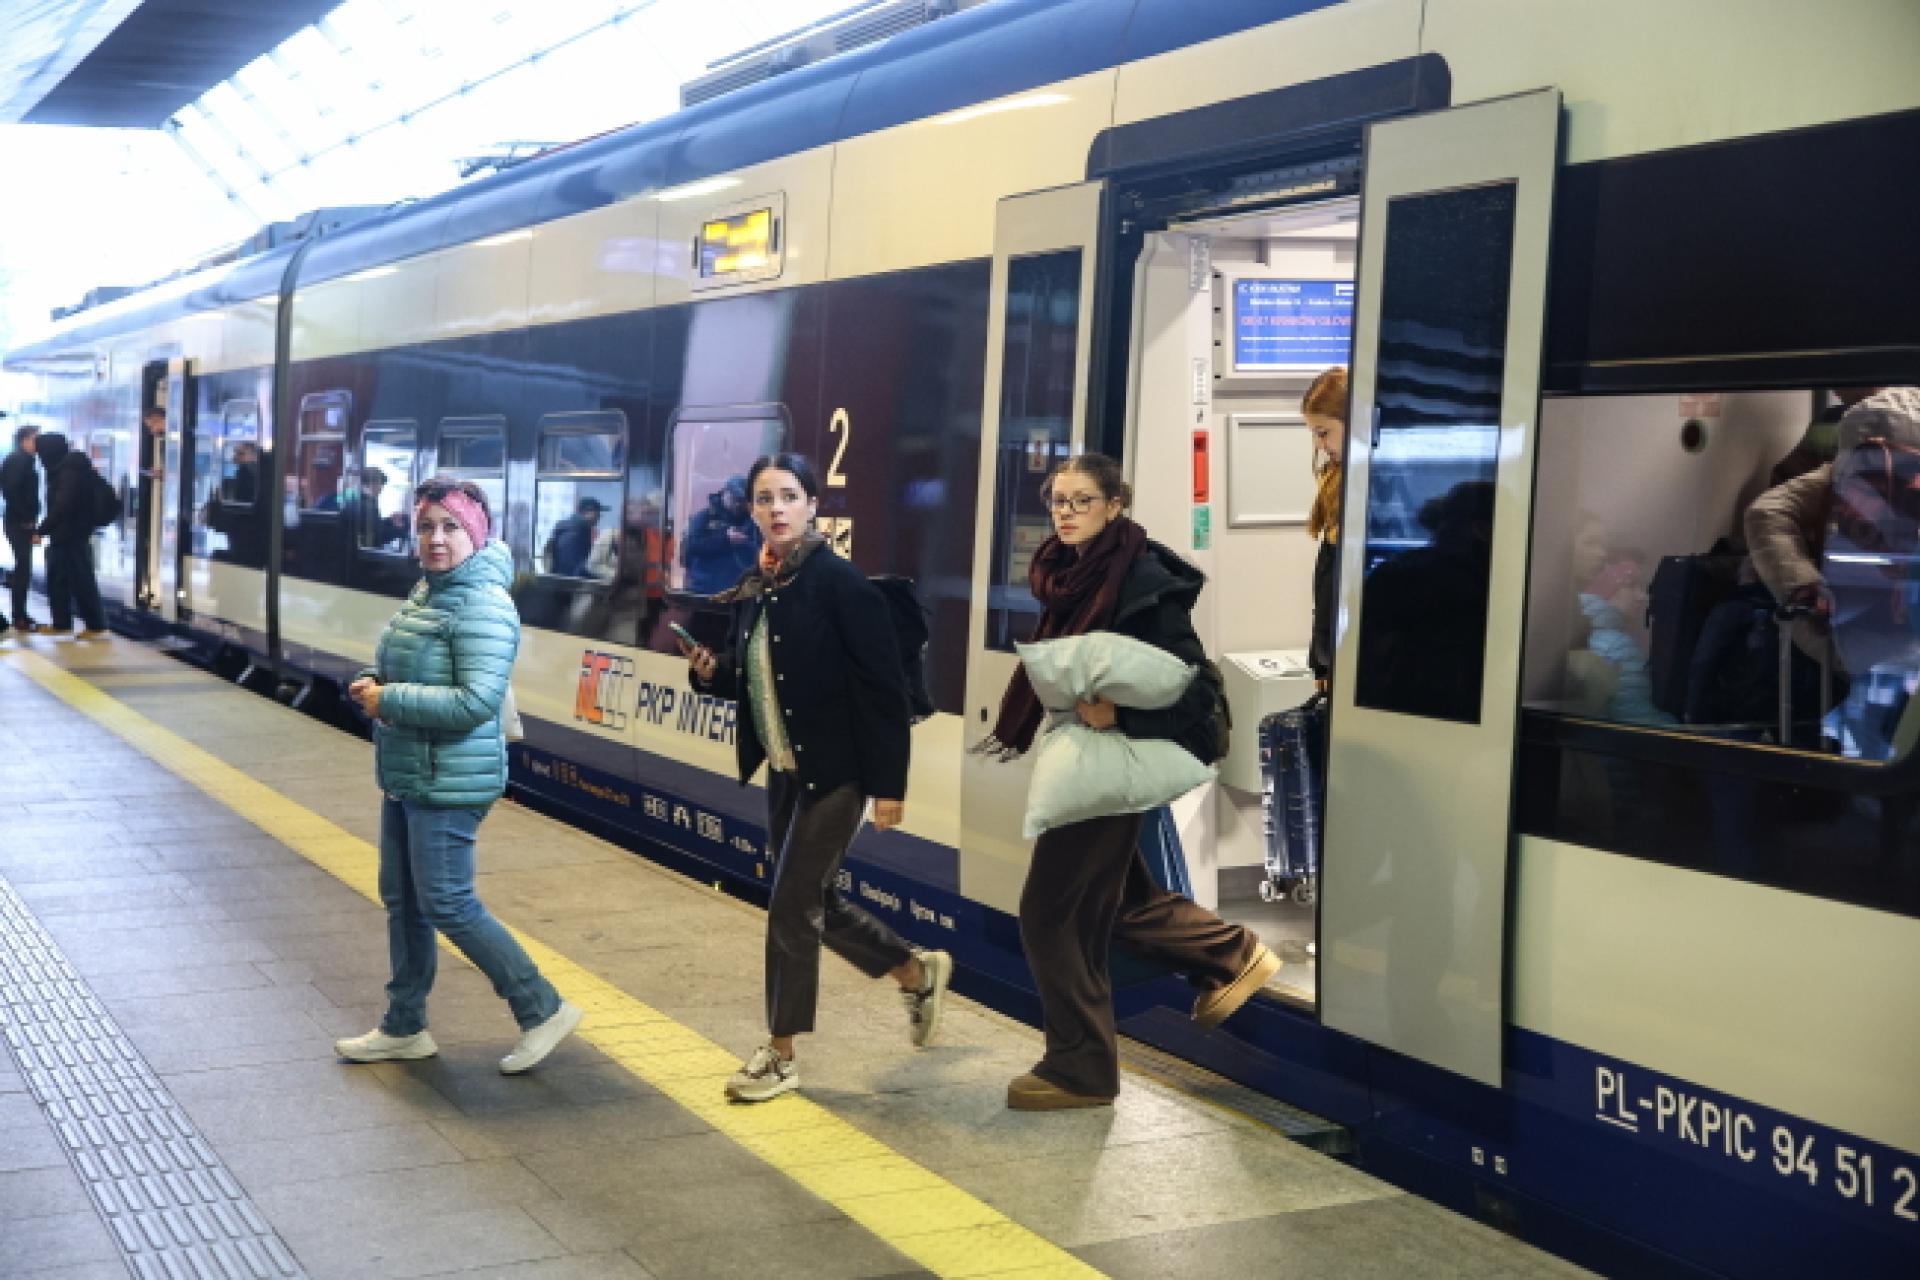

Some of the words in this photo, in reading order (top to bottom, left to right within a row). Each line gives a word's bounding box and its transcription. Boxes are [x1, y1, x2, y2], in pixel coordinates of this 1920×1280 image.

[826, 407, 849, 487] 2
[636, 680, 676, 725] PKP
[676, 690, 737, 746] INTER
[1596, 1066, 1756, 1162] PL-PKPIC
[1772, 1125, 1819, 1186] 94
[1835, 1144, 1874, 1207] 51
[1893, 1166, 1919, 1222] 2
